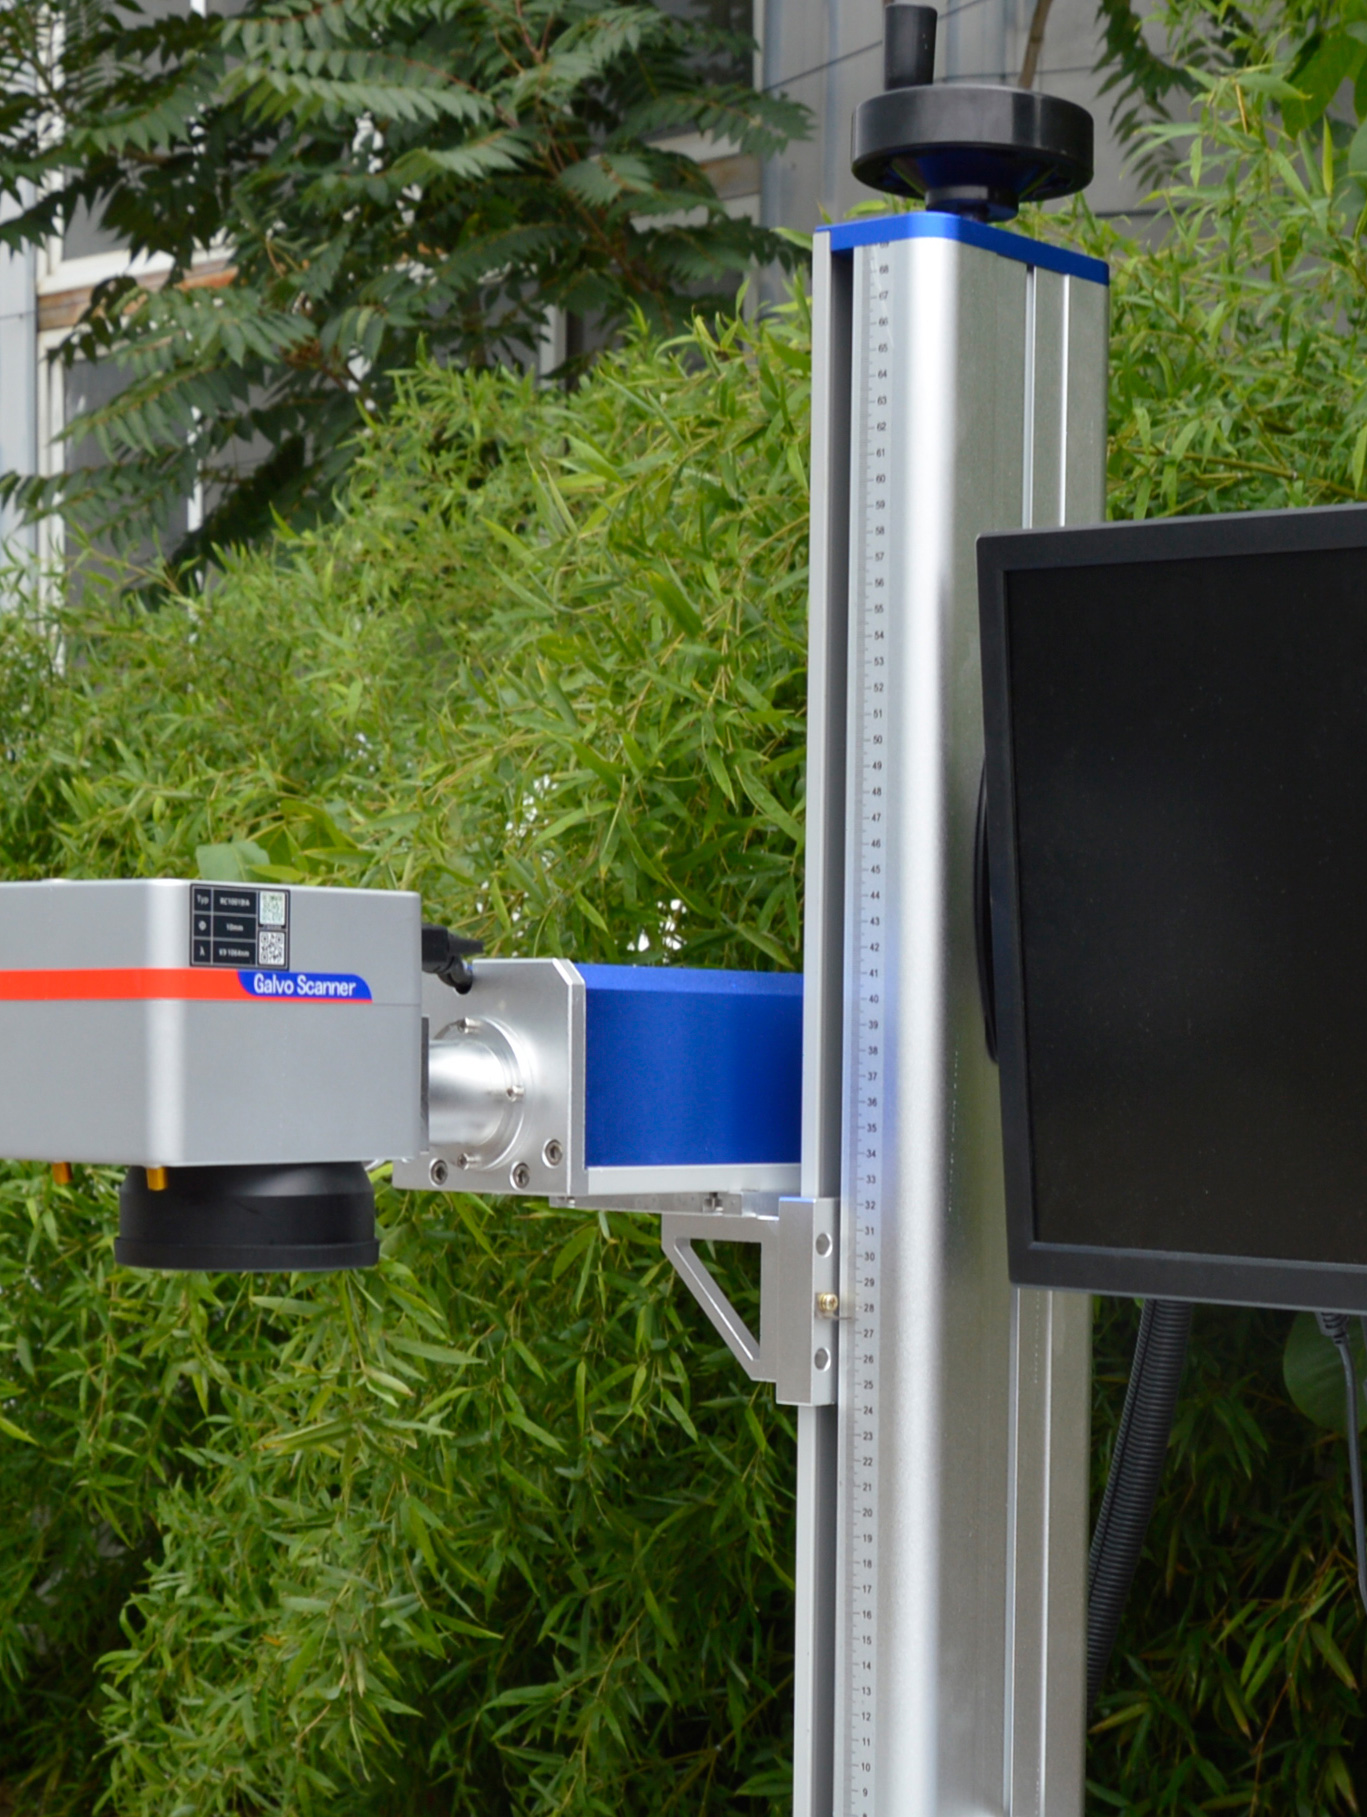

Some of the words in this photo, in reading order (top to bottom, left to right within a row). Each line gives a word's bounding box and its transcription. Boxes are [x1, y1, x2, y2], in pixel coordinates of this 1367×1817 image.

[878, 290, 889, 300] 67
[878, 343, 888, 353] 65
[877, 369, 888, 379] 64
[877, 395, 888, 405] 63
[876, 421, 887, 432] 62
[876, 448, 885, 458] 61
[875, 474, 886, 484] 60
[875, 499, 886, 510] 59
[875, 526, 885, 536] 58
[874, 551, 885, 562] 57
[874, 578, 885, 588] 56
[874, 604, 884, 614] 55
[874, 630, 884, 640] 54
[874, 656, 884, 666] 53
[873, 682, 884, 693] 52
[873, 708, 883, 719] 51
[873, 734, 883, 745] 50
[872, 760, 882, 770] 49
[872, 787, 882, 796] 48
[871, 812, 882, 822] 47
[871, 838, 881, 848] 46
[870, 864, 881, 874] 45
[870, 890, 880, 900] 44
[870, 916, 880, 926] 43
[869, 942, 880, 952] 42
[869, 968, 878, 978] 41
[254, 973, 294, 996] Galvo
[296, 975, 356, 997] Scanner
[868, 994, 879, 1004] 40
[868, 1020, 879, 1030] 39
[868, 1046, 878, 1056] 38
[868, 1071, 878, 1082] 37
[867, 1097, 878, 1107] 36
[867, 1122, 878, 1133] 35
[866, 1148, 876, 1158] 34
[866, 1174, 876, 1184] 33
[865, 1200, 876, 1210] 32
[865, 1226, 875, 1236] 31
[864, 1251, 876, 1262] 30
[864, 1277, 875, 1288] 29
[864, 1303, 875, 1313] 28
[863, 1328, 874, 1338] 27
[863, 1354, 874, 1364] 26
[863, 1379, 874, 1390] 25
[863, 1405, 874, 1415] 24
[863, 1430, 874, 1441] 23
[862, 1456, 873, 1467] 22
[862, 1482, 872, 1492] 21
[862, 1507, 873, 1518] 20
[863, 1533, 873, 1544] 19
[863, 1559, 872, 1569] 18
[862, 1584, 872, 1594] 17
[862, 1610, 872, 1620] 16
[862, 1635, 872, 1646] 15
[862, 1661, 872, 1670] 14
[862, 1686, 872, 1696] 13
[861, 1711, 872, 1722] 12
[862, 1737, 871, 1747] 11
[861, 1762, 871, 1772] 10
[862, 1787, 868, 1797] 9
